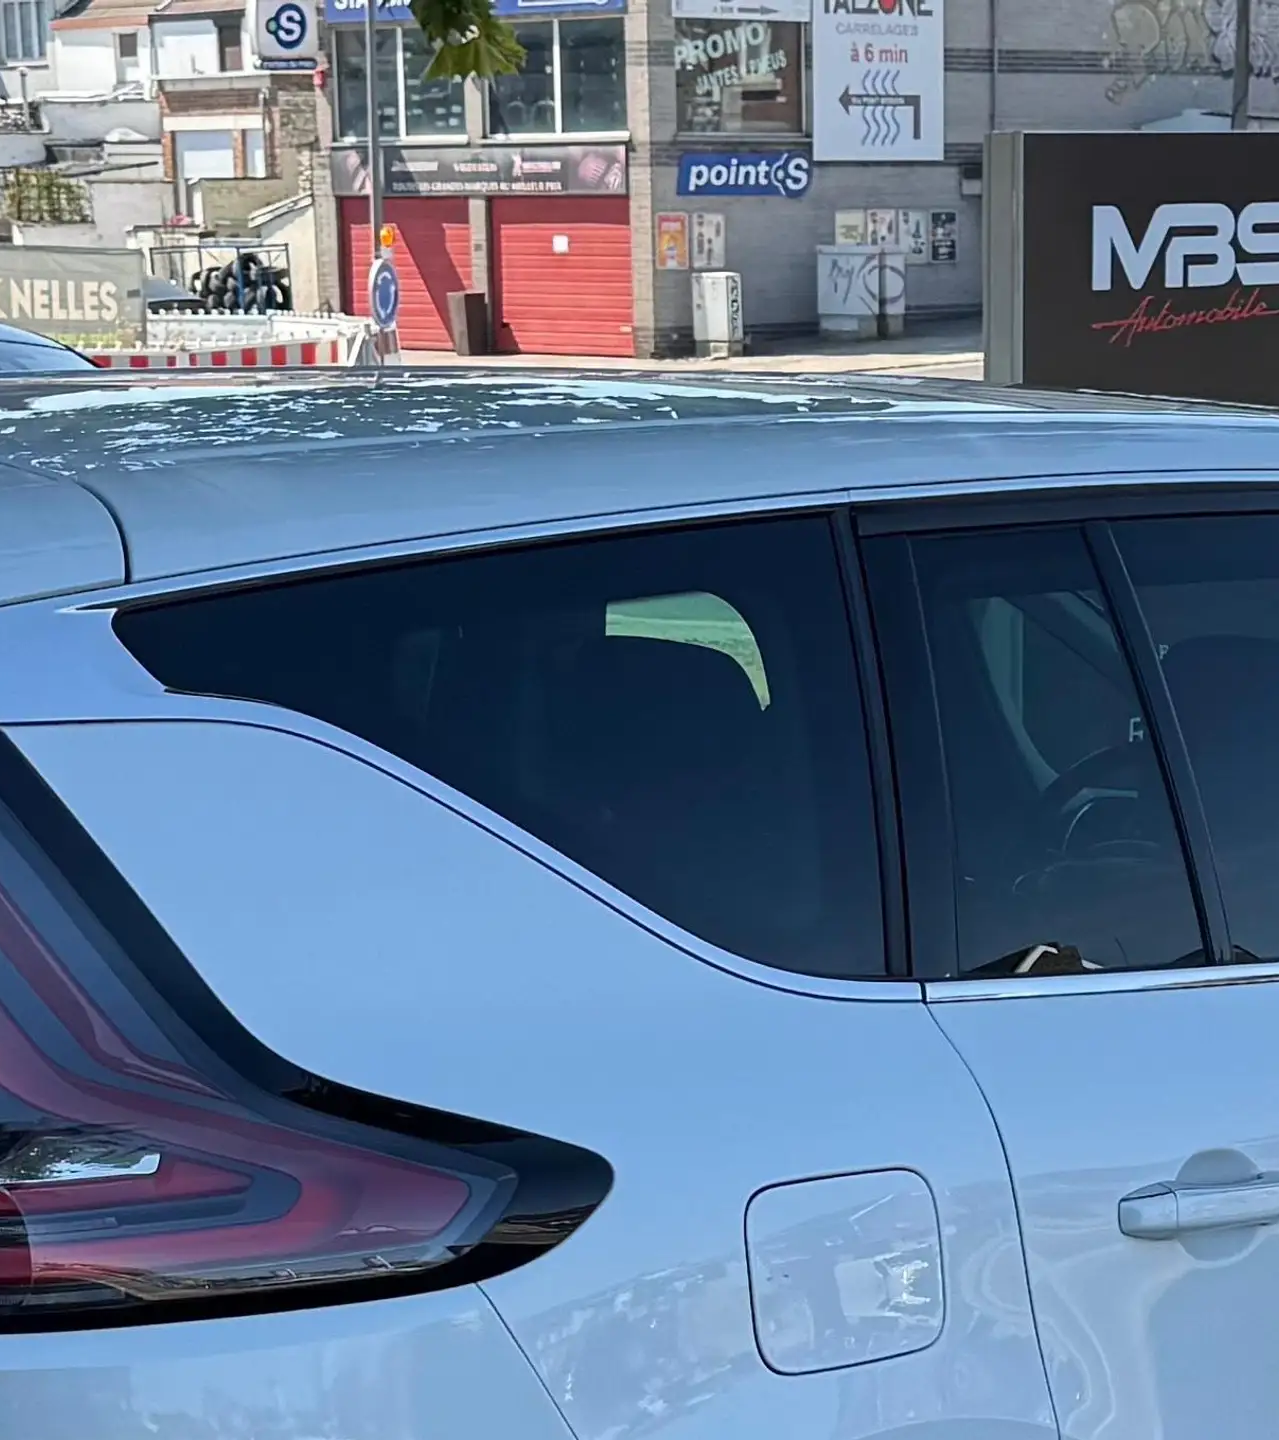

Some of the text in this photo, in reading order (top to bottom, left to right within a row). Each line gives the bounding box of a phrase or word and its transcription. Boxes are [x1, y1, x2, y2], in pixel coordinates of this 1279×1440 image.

[835, 21, 919, 36] CARRELAGES
[673, 22, 765, 71] PROMO
[864, 42, 875, 63] 6
[878, 44, 909, 63] min
[688, 158, 770, 192] point
[10, 277, 118, 321] NELLES
